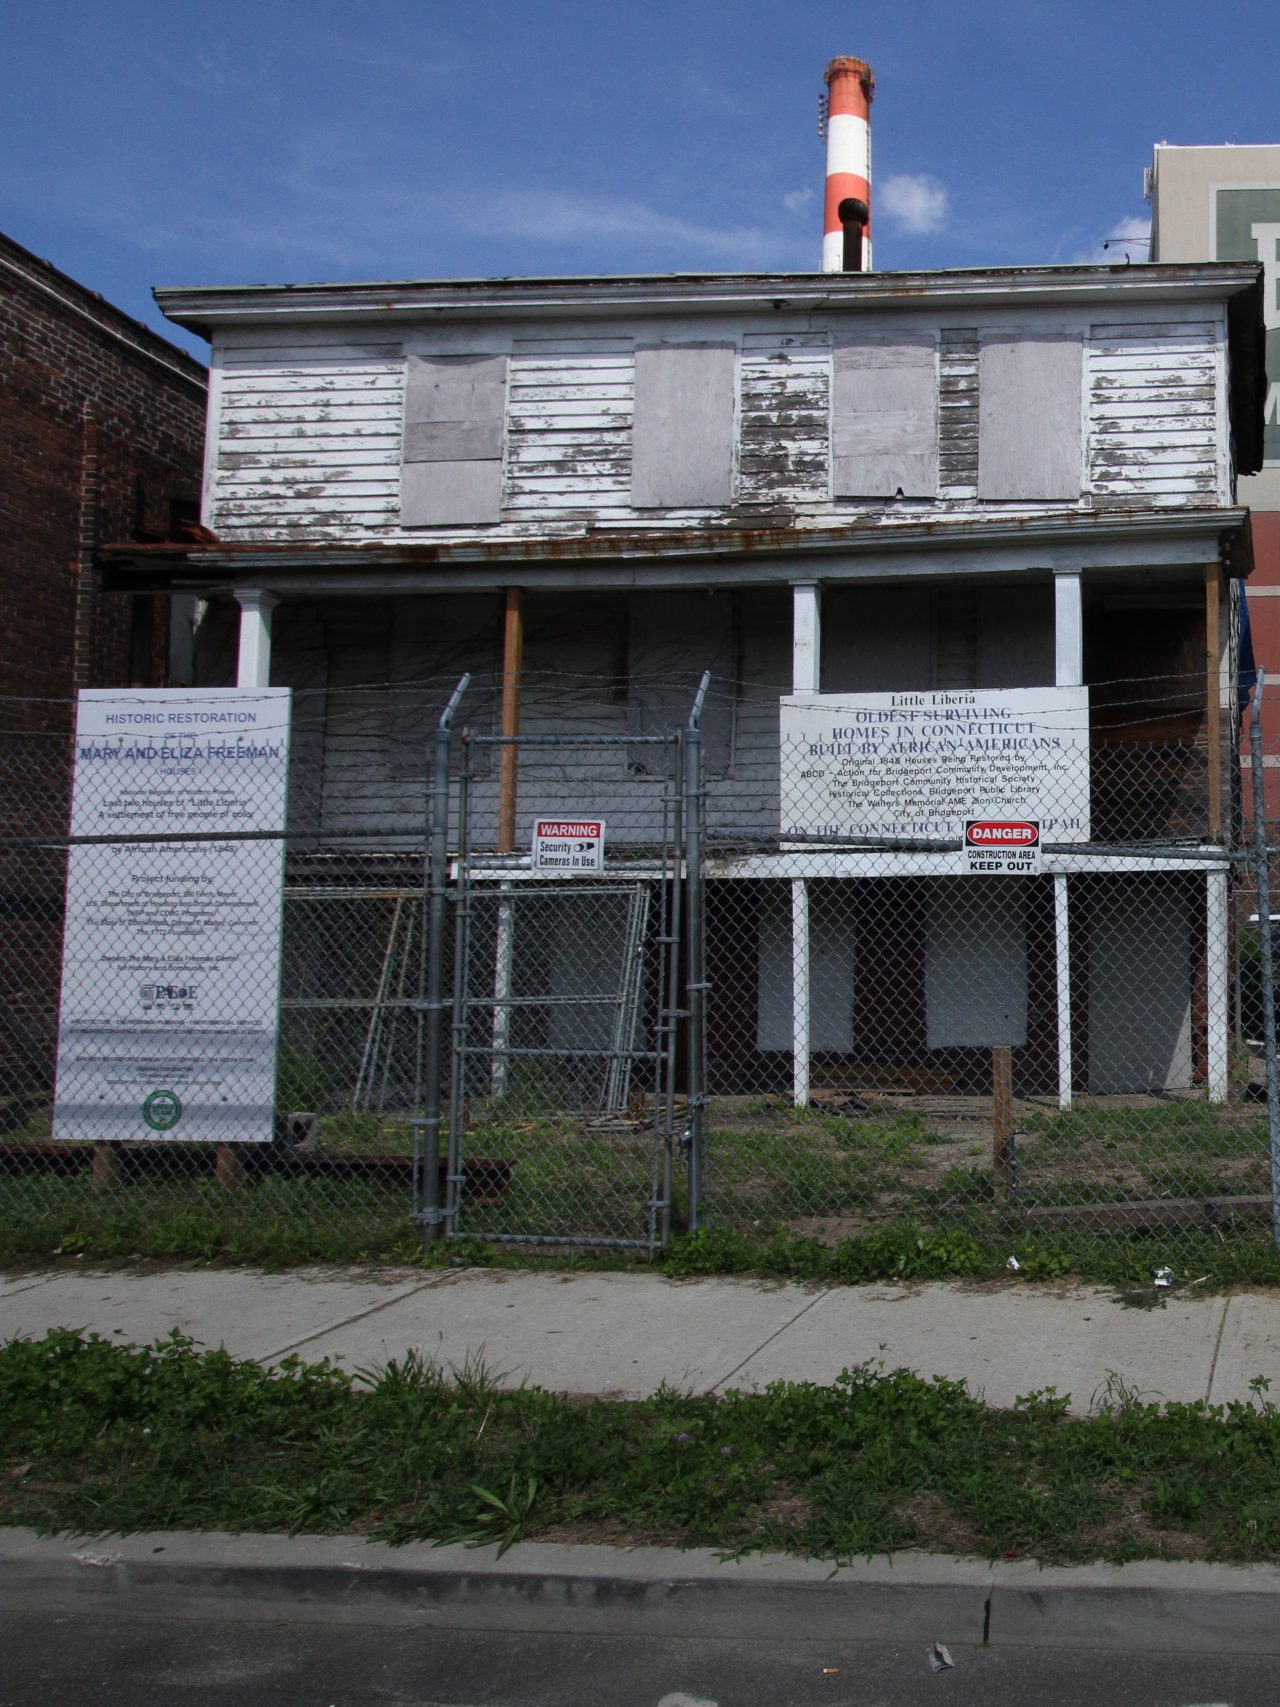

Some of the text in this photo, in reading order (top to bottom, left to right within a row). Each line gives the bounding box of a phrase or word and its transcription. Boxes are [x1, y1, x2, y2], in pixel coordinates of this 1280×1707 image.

[891, 693, 976, 706] Little Liberia
[105, 712, 257, 724] HISTORIC RESTORATION
[855, 707, 1011, 723] OLDEST SURVIVING
[179, 732, 196, 740] THE
[832, 722, 1037, 739] HOMES IN CONNECTICUT
[80, 746, 279, 759] MARY AND ELIZA FREEMAN
[809, 743, 855, 756] BUILT
[861, 742, 879, 755] BY
[841, 758, 875, 767] Original
[941, 755, 966, 764] Being
[970, 754, 1010, 762] Restored
[1014, 754, 1025, 762] by
[800, 770, 825, 778] ABCD
[837, 768, 865, 776] Action
[870, 768, 881, 776] for
[885, 767, 932, 777] Bridgeport
[852, 779, 899, 788] Bridgeport
[902, 777, 951, 786] Community
[955, 776, 998, 784] Historical
[1001, 775, 1035, 784] Society
[829, 790, 869, 798] Historical
[929, 787, 975, 796] Bridgeport
[979, 786, 1005, 794] Public
[1010, 786, 1041, 795] Library
[142, 799, 173, 807] houses
[176, 799, 184, 807] of
[847, 796, 1026, 808] The Walters Memorial AME Zion Church
[188, 811, 218, 819] people
[893, 807, 975, 819] City of Bridgeport
[540, 824, 597, 836] WARNING
[787, 825, 808, 835] ON
[972, 828, 1032, 839] DANGER
[540, 841, 572, 854] Security
[967, 850, 1036, 859] CONSTRUCTION AREA
[540, 855, 595, 867] Cameras In Use
[969, 861, 1003, 871] KEEP
[1007, 861, 1033, 871] OUT
[131, 875, 163, 884] Project
